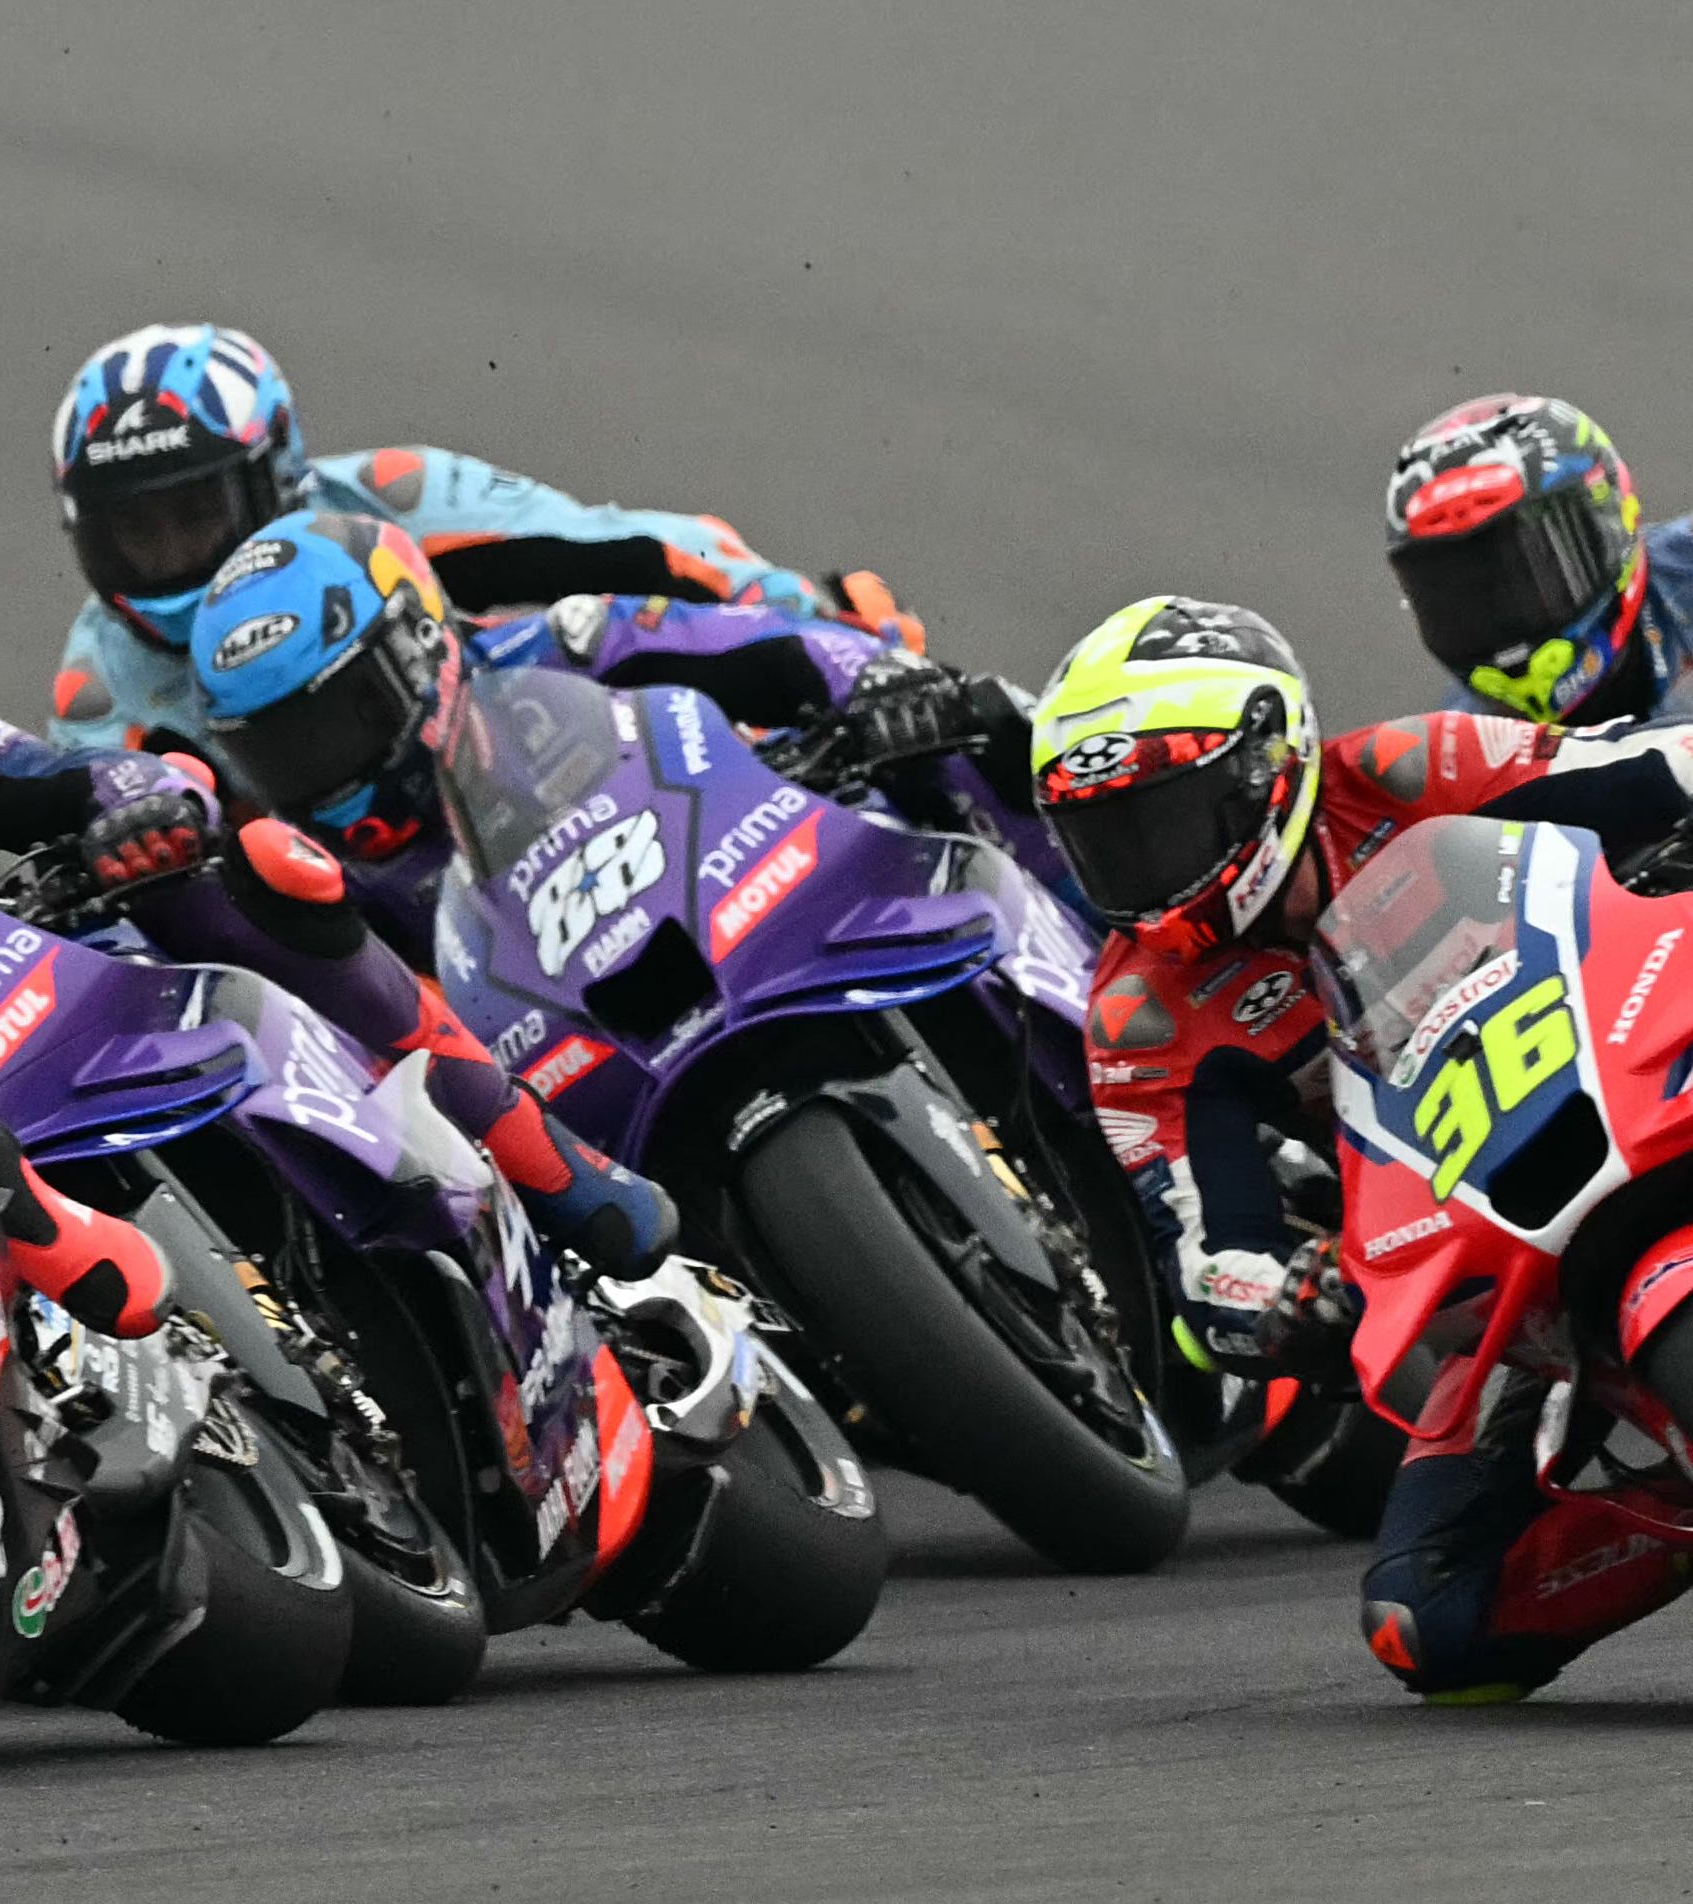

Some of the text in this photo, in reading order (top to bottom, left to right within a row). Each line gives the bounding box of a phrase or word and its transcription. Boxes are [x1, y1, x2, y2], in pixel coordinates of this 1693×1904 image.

[86, 422, 191, 466] SHARK
[215, 615, 295, 669] HJC
[509, 793, 618, 903] prima
[699, 786, 807, 889] prima
[528, 809, 667, 977] 88
[716, 844, 813, 940] MOTUL
[1416, 960, 1511, 1055] Castrol
[1607, 928, 1685, 1045] HONDA
[526, 1039, 596, 1100] OTUL
[1414, 974, 1578, 1201] 36
[1363, 1210, 1454, 1262] HONDA
